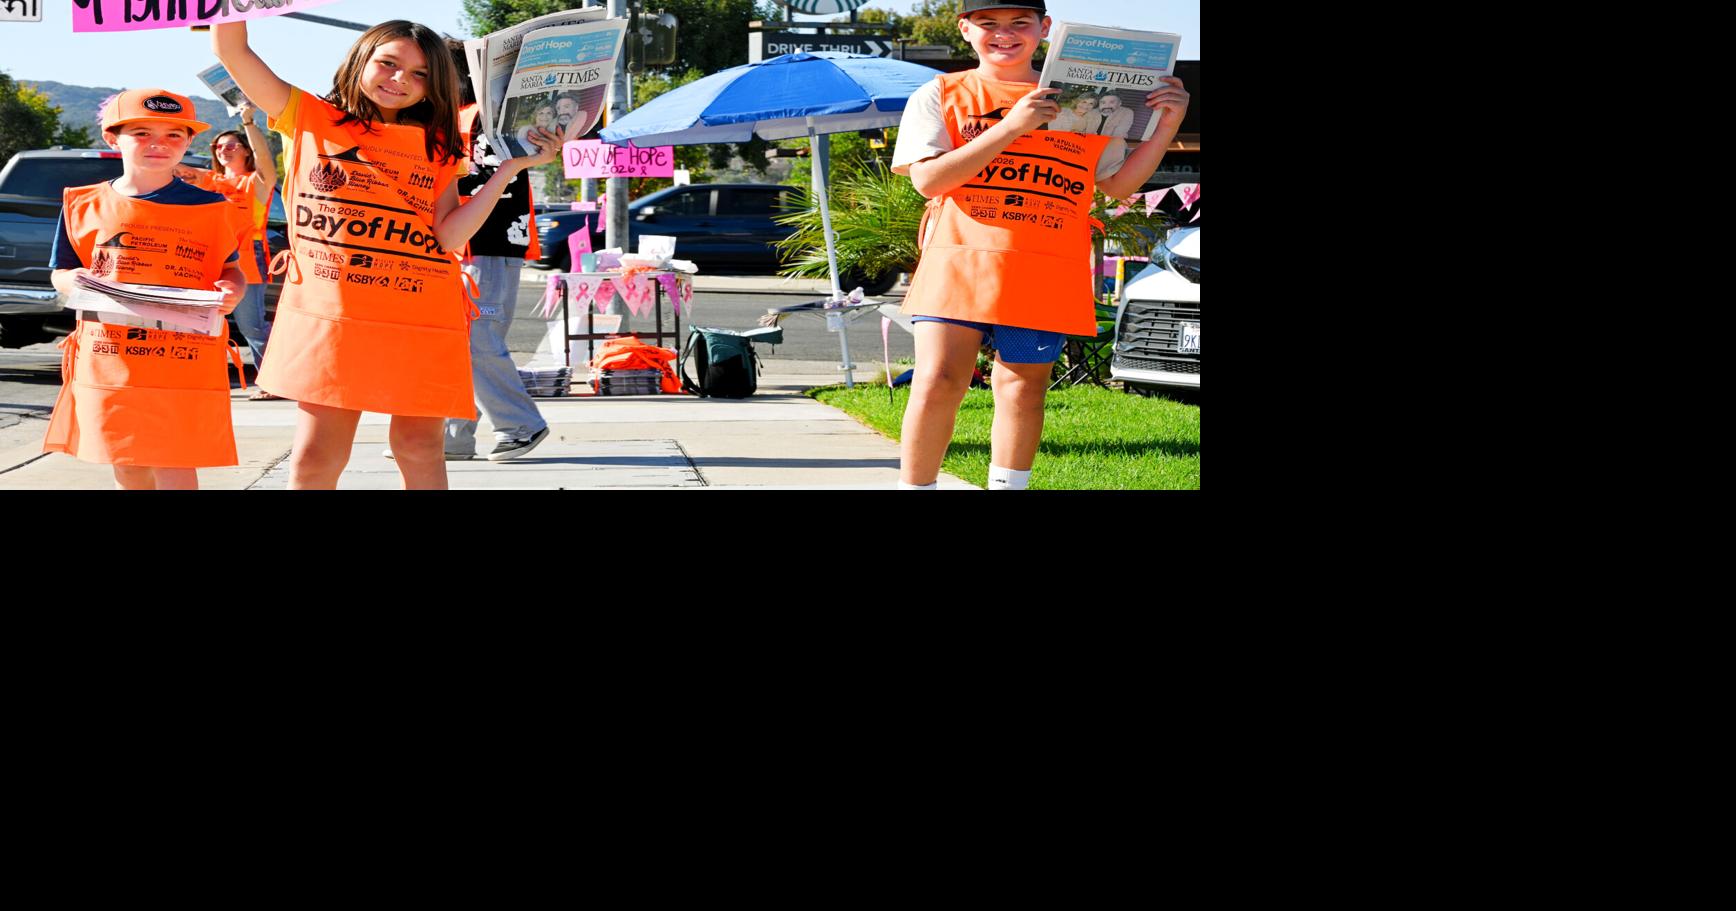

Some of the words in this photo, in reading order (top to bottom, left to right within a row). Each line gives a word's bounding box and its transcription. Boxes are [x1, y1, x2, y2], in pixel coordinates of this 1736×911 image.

[545, 40, 572, 50] Hope
[768, 42, 812, 54] DRIVE
[820, 44, 860, 54] THRU
[1066, 37, 1084, 47] Day
[1097, 39, 1124, 51] Hope
[557, 68, 600, 84] TIMES
[1067, 72, 1092, 80] MARIA
[1068, 66, 1092, 75] SANTA
[520, 81, 542, 89] MARIA
[1108, 72, 1154, 86] TIMES
[570, 148, 599, 167] DAY
[604, 146, 623, 165] OF
[601, 166, 635, 174] 2026
[1000, 163, 1030, 181] of
[1033, 165, 1084, 194] Hope
[397, 188, 408, 197] DR.
[410, 195, 428, 206] ATUL
[972, 194, 1000, 204] TIMES
[318, 204, 336, 214] The
[338, 207, 365, 218] 2026
[1002, 211, 1027, 221] KSBY
[296, 204, 346, 238] Day
[347, 216, 383, 238] of
[315, 250, 345, 263] TIMES
[346, 273, 375, 285] KSBY
[126, 346, 152, 356] KSBY
